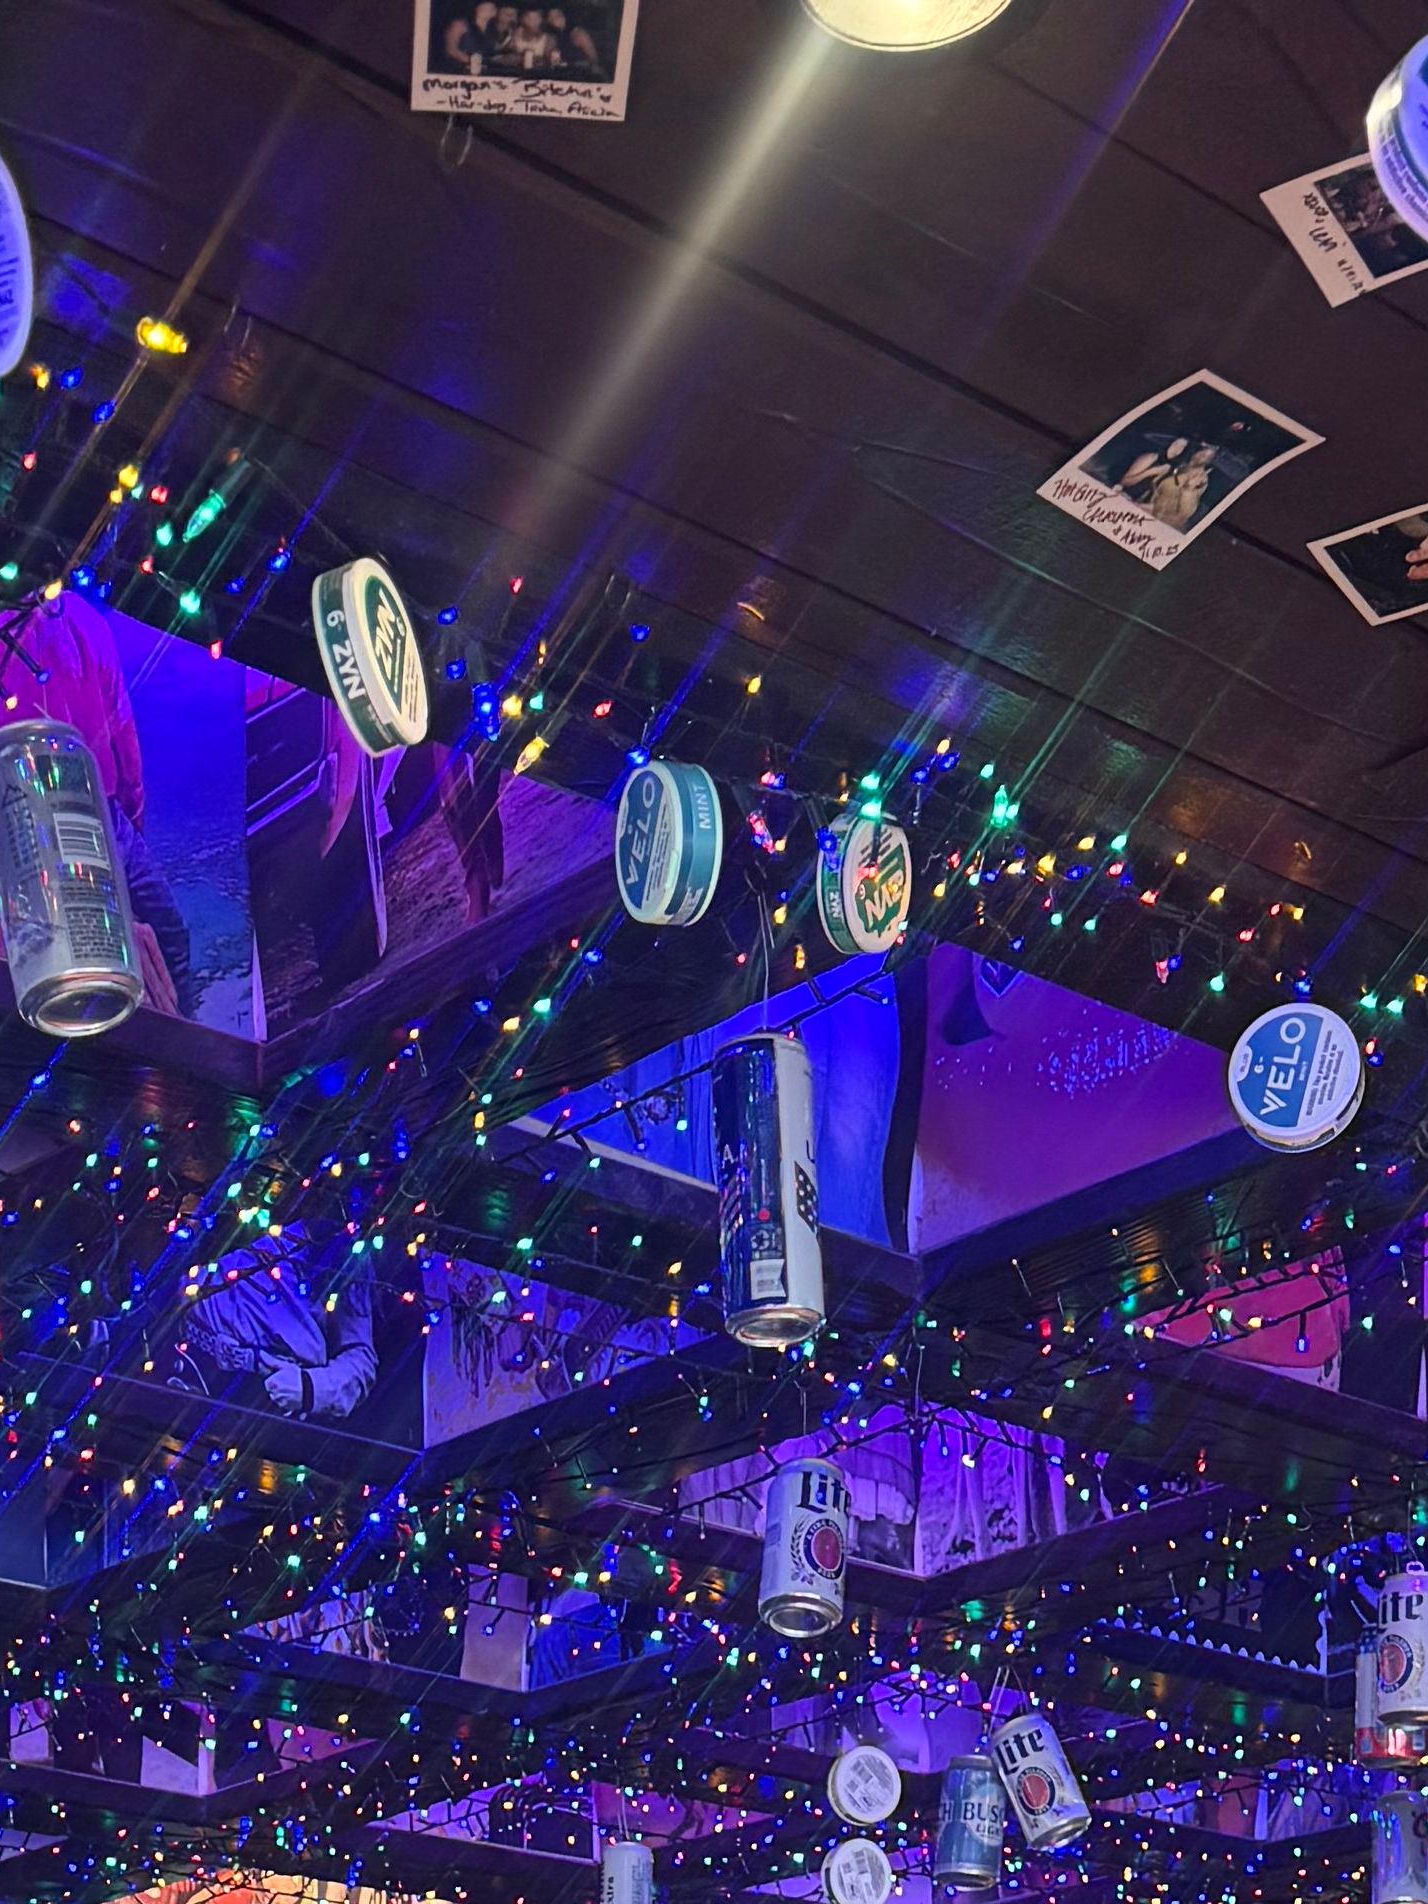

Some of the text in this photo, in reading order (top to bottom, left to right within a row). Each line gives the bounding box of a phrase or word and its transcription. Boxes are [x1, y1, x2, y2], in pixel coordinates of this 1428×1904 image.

[326, 610, 367, 700] 6 ZYN
[373, 587, 403, 679] ZYN
[626, 780, 657, 886] VELO
[699, 783, 712, 830] MINT
[830, 887, 843, 918] ZYN
[1260, 1017, 1306, 1116] VELO
[994, 1728, 1046, 1776] Lite
